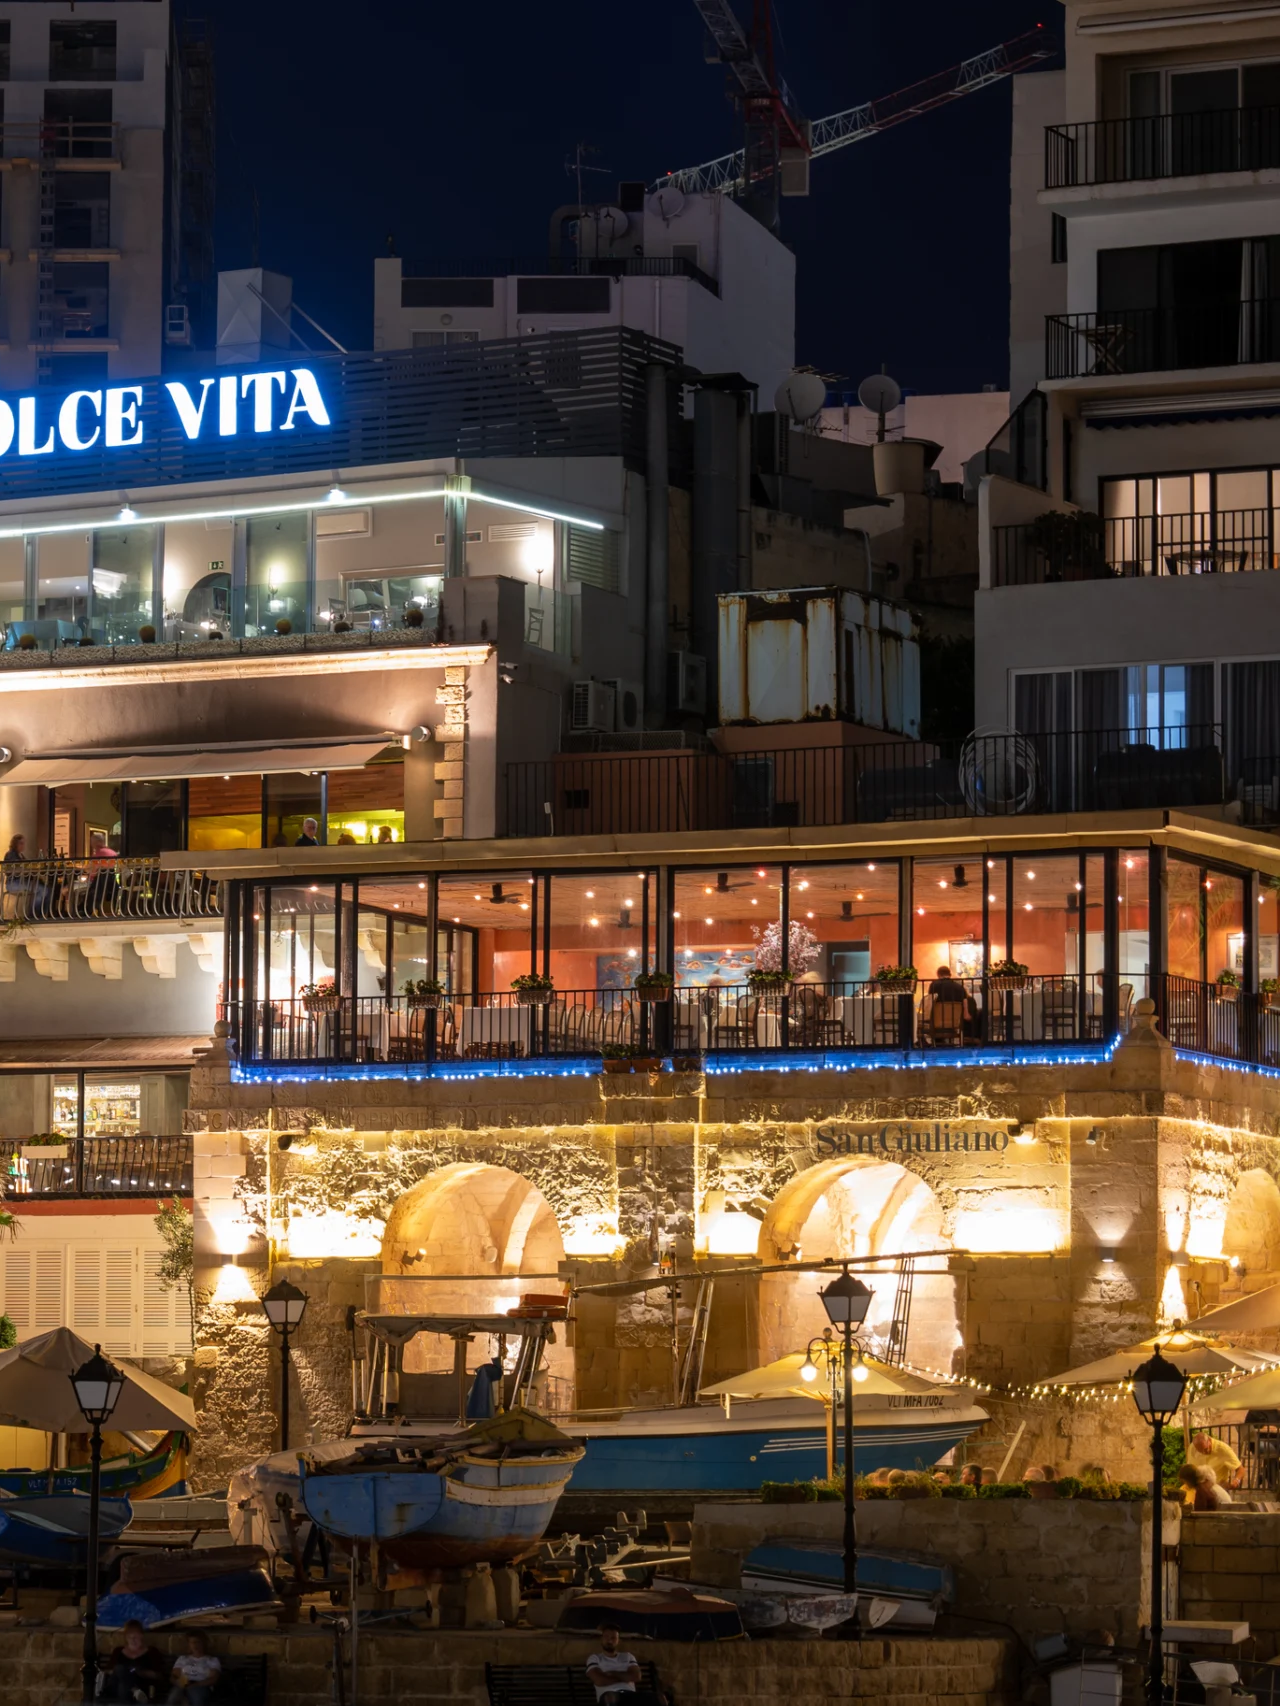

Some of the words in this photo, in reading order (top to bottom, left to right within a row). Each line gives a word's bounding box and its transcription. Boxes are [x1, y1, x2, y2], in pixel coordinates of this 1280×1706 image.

[165, 369, 331, 440] VITA
[815, 1124, 874, 1155] San
[879, 1123, 1009, 1153] Giuliano
